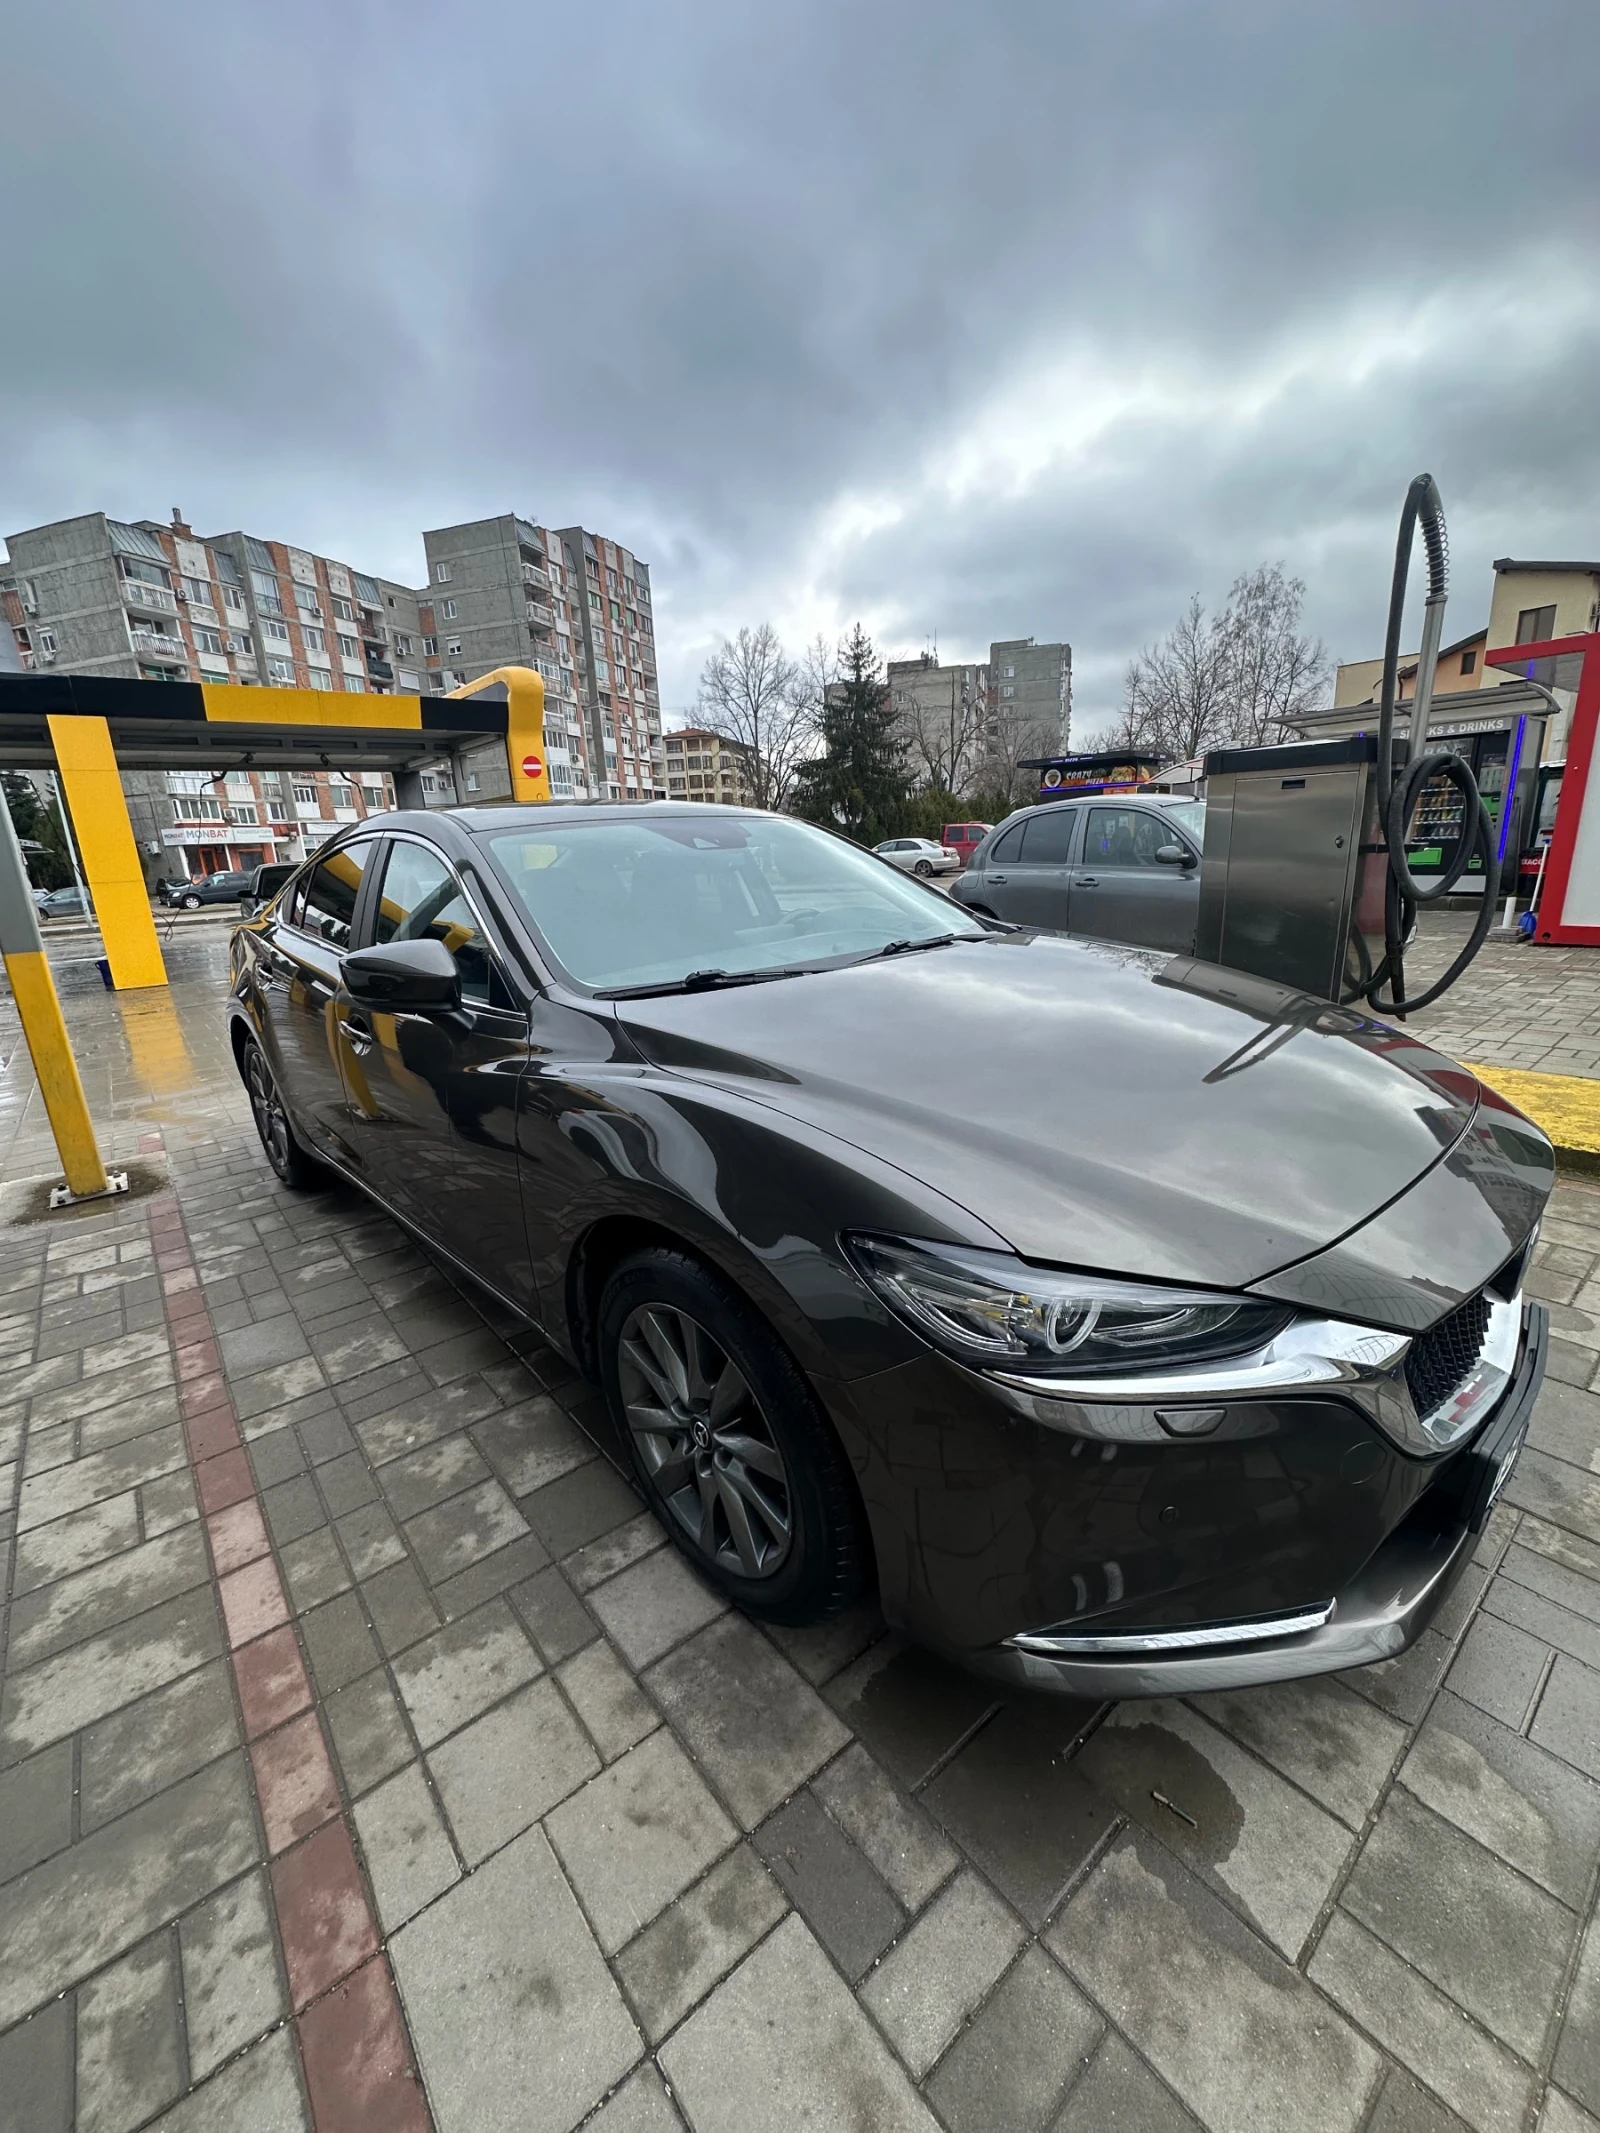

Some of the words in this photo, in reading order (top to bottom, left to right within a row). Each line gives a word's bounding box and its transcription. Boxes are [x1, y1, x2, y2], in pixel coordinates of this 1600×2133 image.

[1400, 725, 1443, 739] SKS
[1447, 724, 1455, 734] &
[1459, 719, 1504, 733] DRINKS
[1066, 770, 1092, 780] CRAZY
[186, 830, 228, 838] MONBAT
